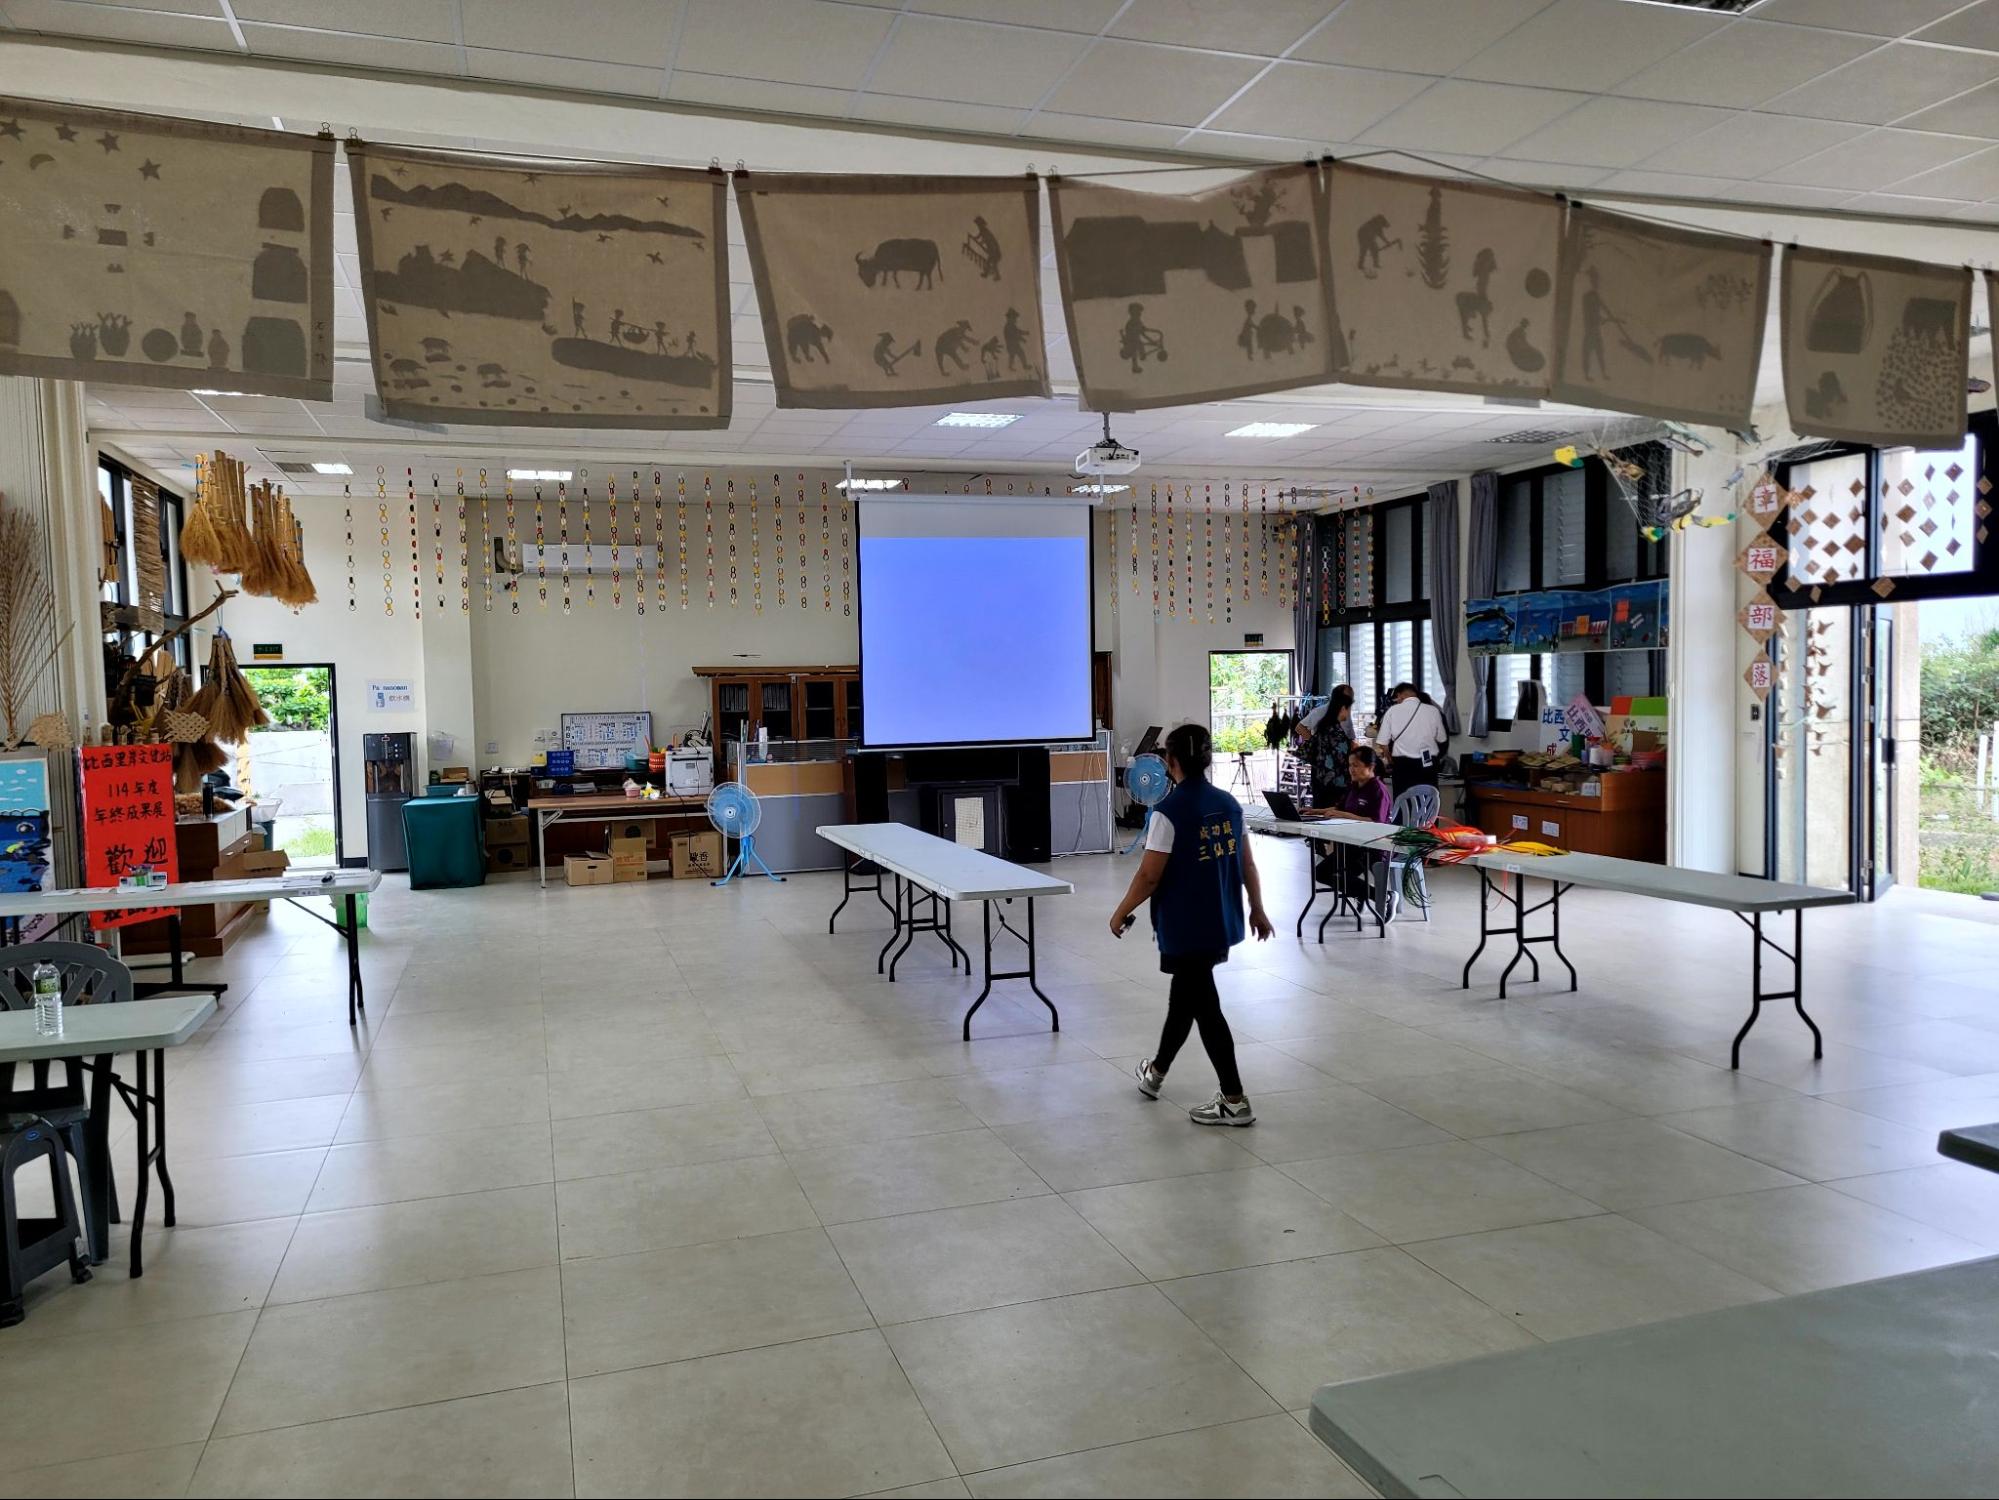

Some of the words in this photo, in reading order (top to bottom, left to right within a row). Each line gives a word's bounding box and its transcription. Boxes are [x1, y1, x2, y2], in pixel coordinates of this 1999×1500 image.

[94, 801, 166, 825] 年終成果展
[1200, 820, 1233, 840] 成功鎮
